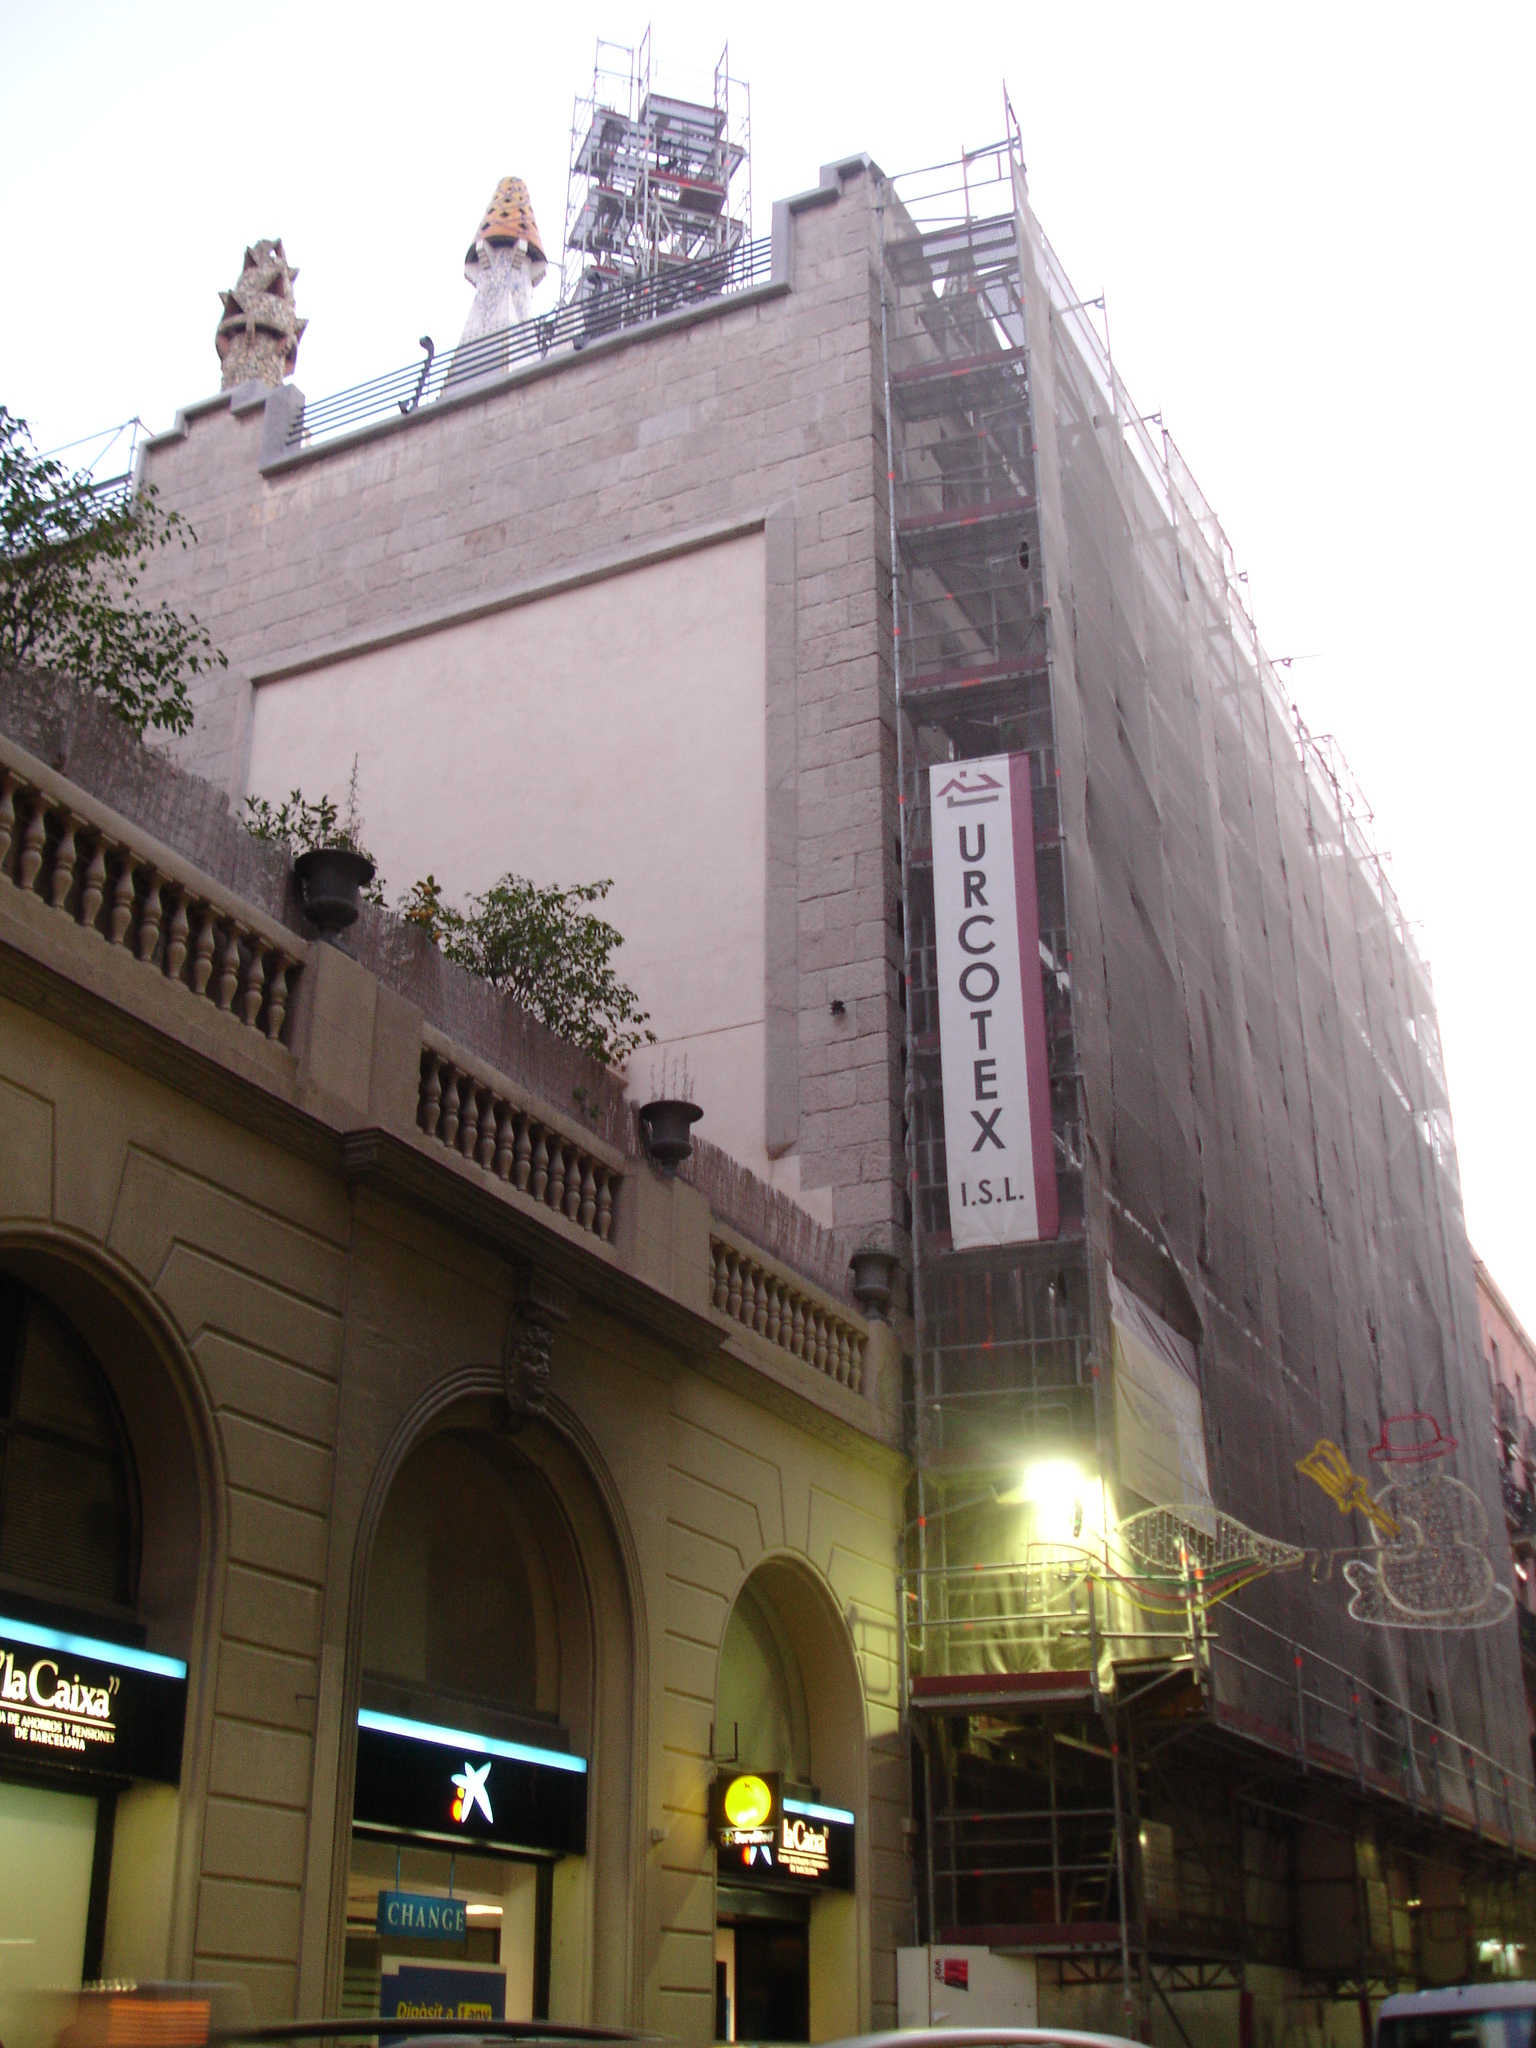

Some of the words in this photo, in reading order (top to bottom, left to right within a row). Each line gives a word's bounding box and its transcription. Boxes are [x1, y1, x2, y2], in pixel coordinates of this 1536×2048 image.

[957, 823, 1006, 1153] URCOTEX
[960, 1176, 1025, 1207] I.S.L.
[7, 1712, 21, 1726] DE
[20, 1715, 63, 1734] AHORROS
[64, 1722, 71, 1735] Y
[71, 1723, 116, 1744] PENSIONES
[14, 1725, 29, 1740] DE
[29, 1728, 86, 1752] BARCELONA
[387, 1901, 464, 1932] CHANGE
